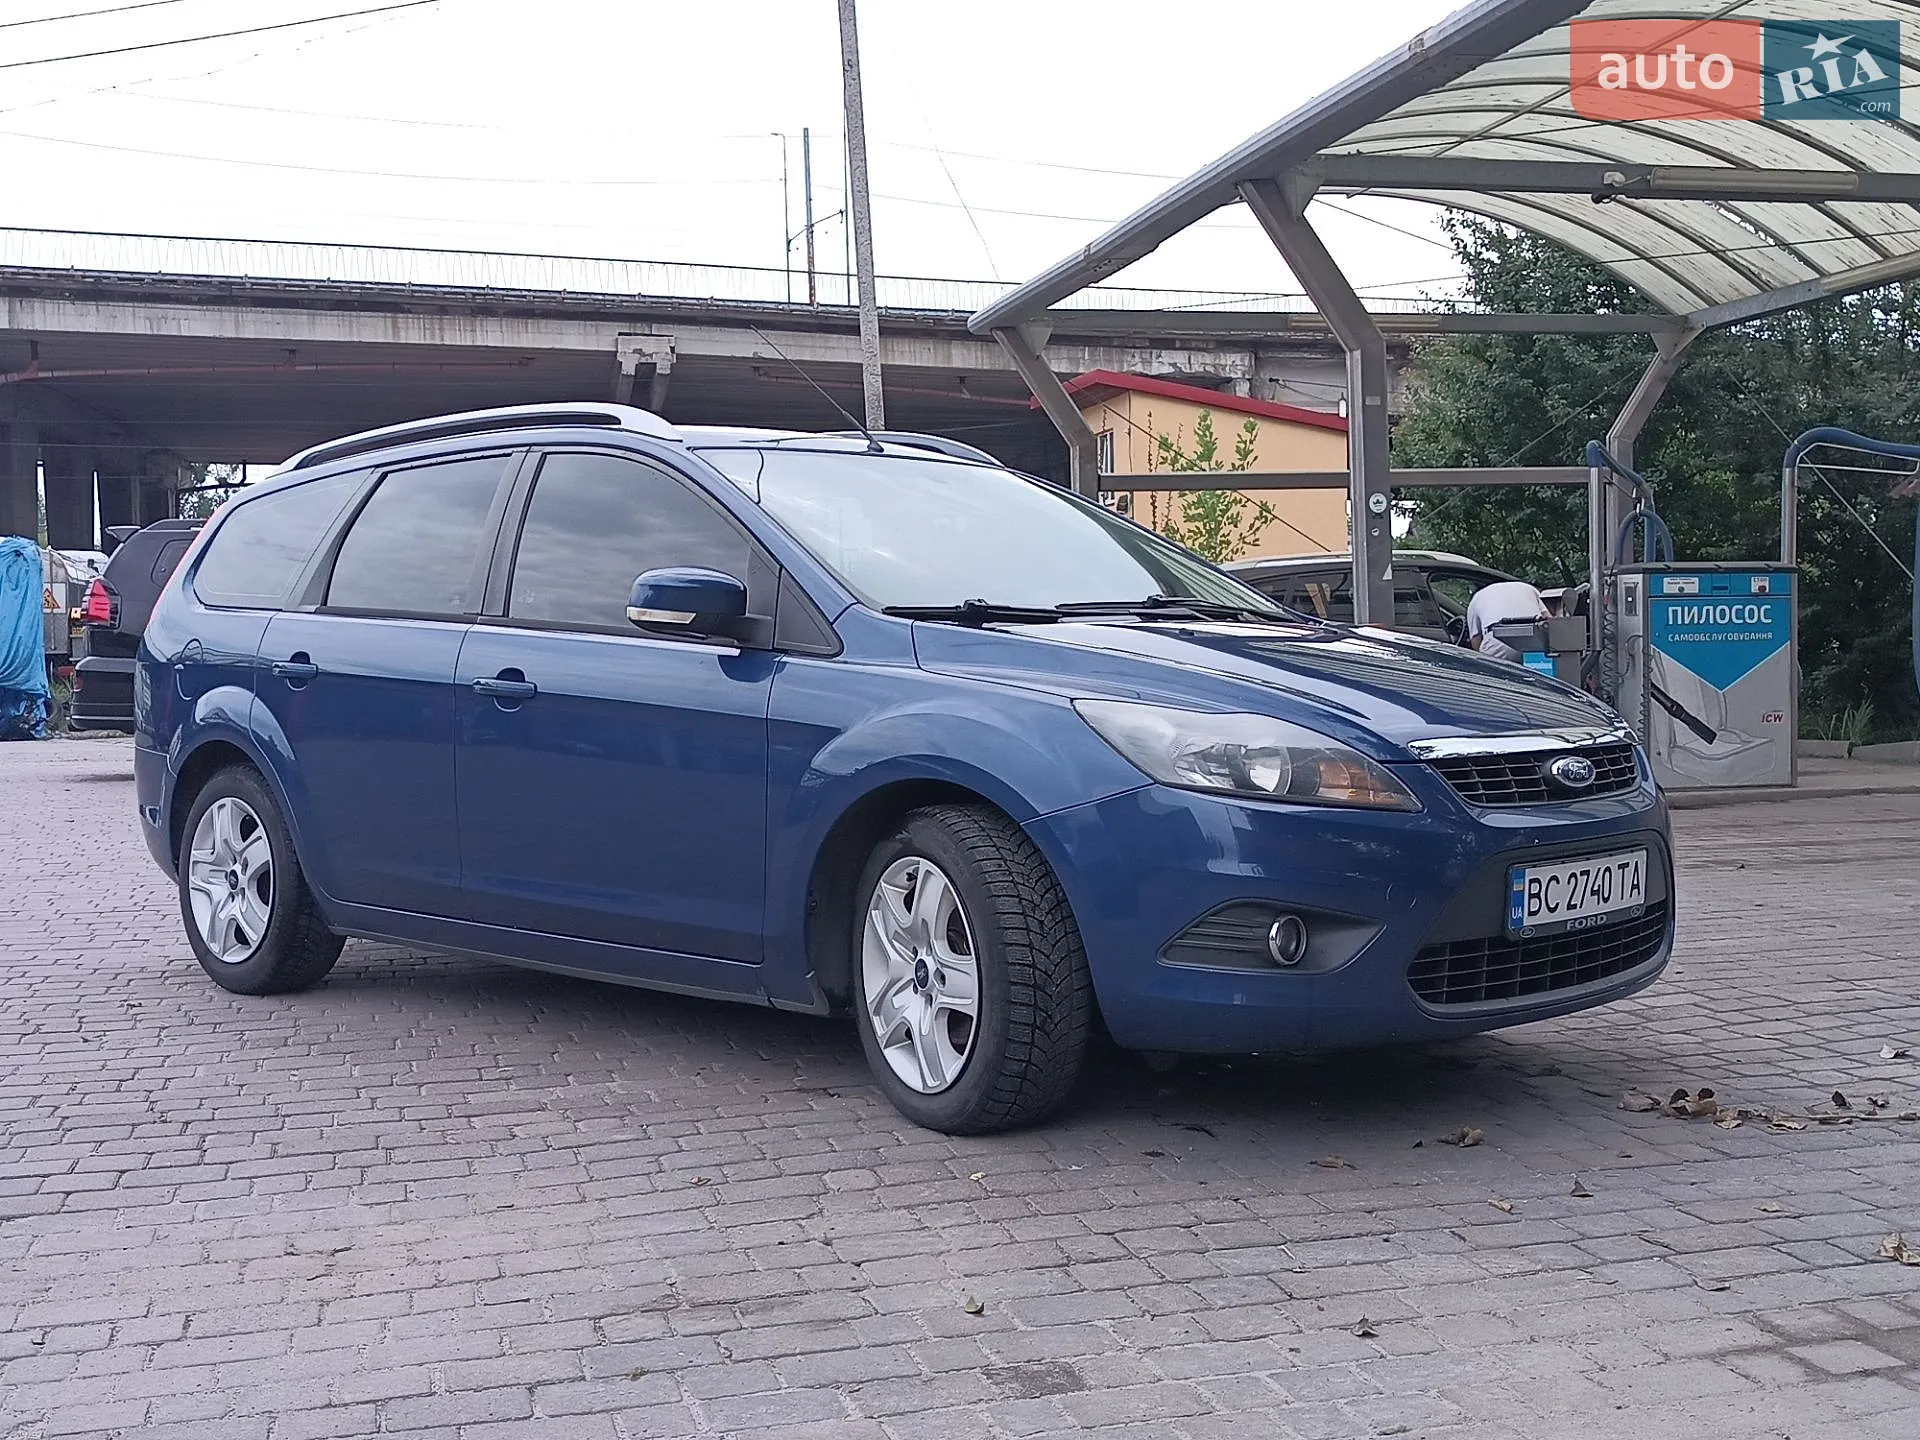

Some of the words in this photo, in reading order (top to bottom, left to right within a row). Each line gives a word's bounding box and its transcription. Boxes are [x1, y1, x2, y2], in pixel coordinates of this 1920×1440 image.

[1668, 604, 1773, 625] ПИЛОСОС
[1527, 875, 1561, 917] BC
[1566, 867, 1612, 911] 2740
[1617, 860, 1641, 901] TA
[1511, 908, 1523, 919] UA
[1566, 914, 1607, 931] FORD
